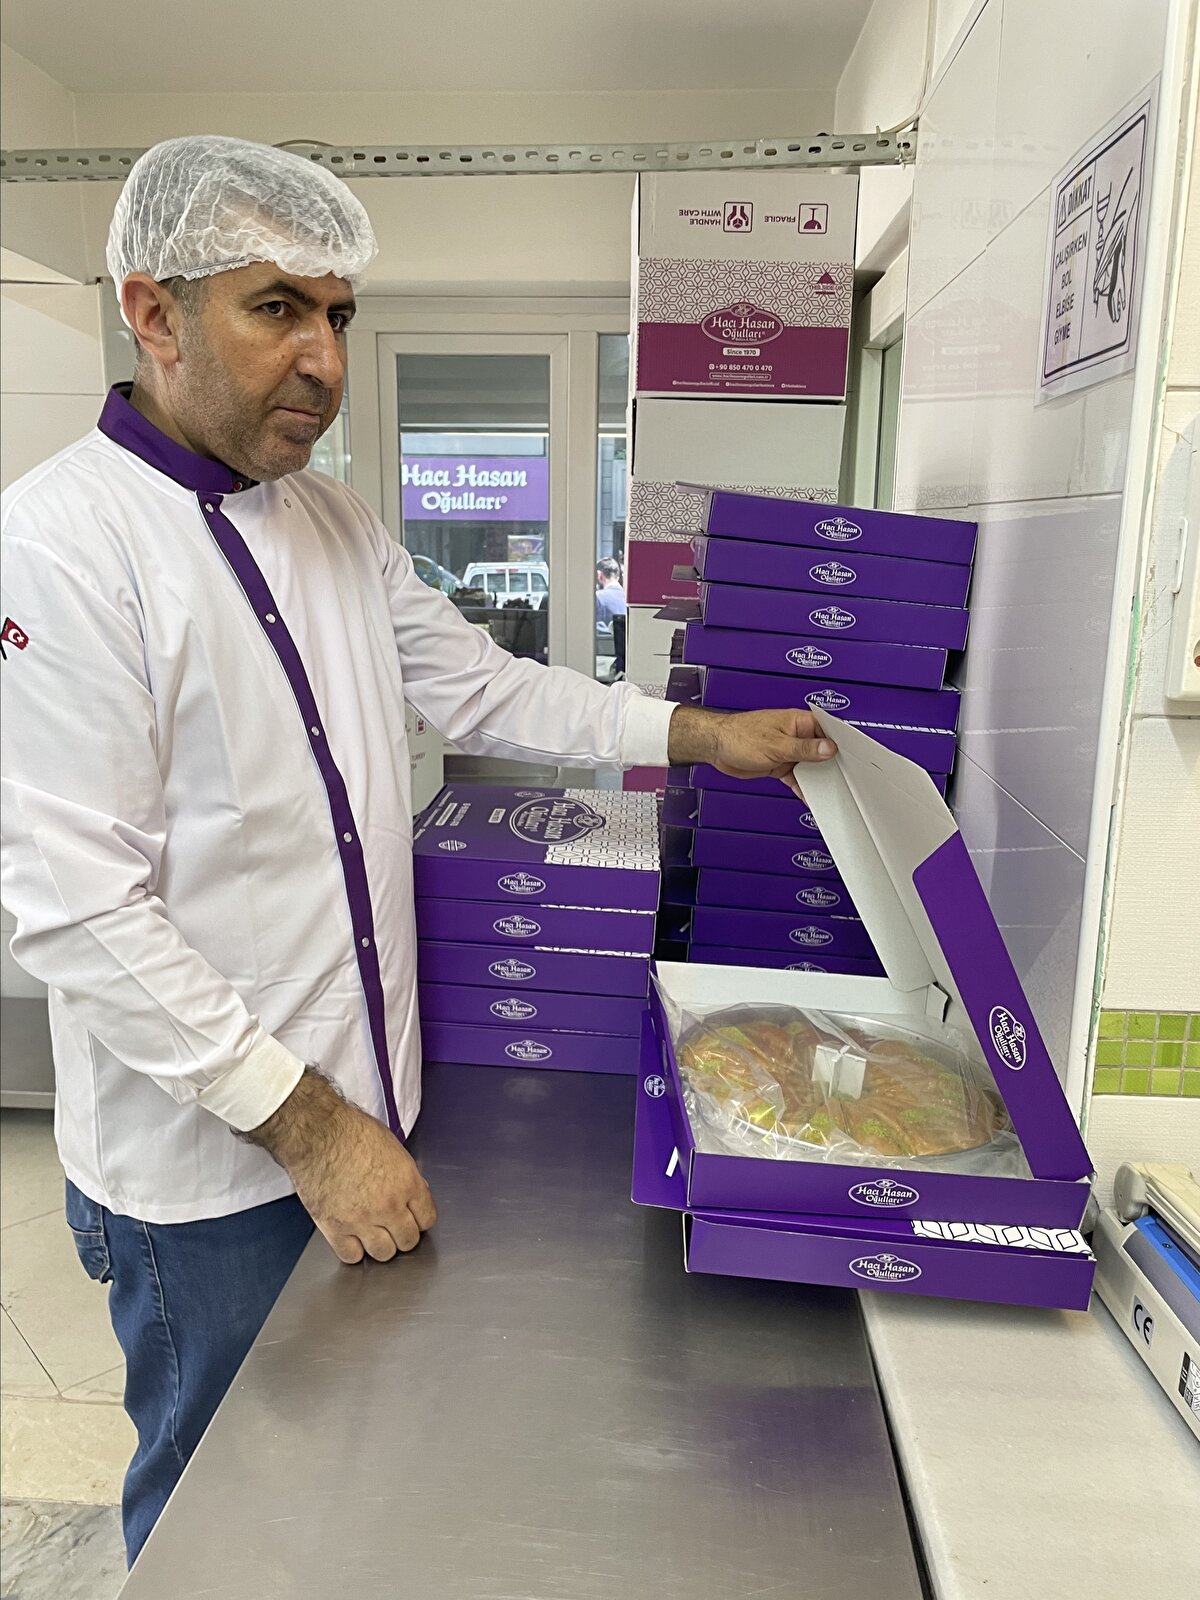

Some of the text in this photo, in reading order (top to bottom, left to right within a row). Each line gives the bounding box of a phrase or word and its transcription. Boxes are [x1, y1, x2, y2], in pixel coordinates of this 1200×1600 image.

[1068, 174, 1092, 216] DİKKAT
[678, 209, 722, 217] WITH CARE
[764, 215, 796, 223] FRAGILE
[689, 218, 721, 226] HANDLE
[1055, 231, 1088, 273] ÇALIŞIRKEN
[1061, 269, 1072, 290] BOL
[710, 316, 775, 329] Hacı Hasan
[722, 328, 761, 340] Oğulları
[401, 464, 528, 487] Hacı Hasan
[421, 491, 502, 513] Oğulları
[836, 525, 858, 533] Hasan
[831, 569, 852, 578] Hasan
[830, 614, 852, 622] Hasan
[807, 653, 828, 661] Hasan
[996, 1012, 1010, 1034] Hacı
[1005, 1034, 1022, 1063] Hasan
[857, 1186, 912, 1198] Hacı Hasan
[866, 1195, 900, 1204] Oğulları
[857, 1259, 914, 1273] Hacı Hasan
[867, 1269, 902, 1278] Oğulları
[1134, 1304, 1153, 1345] CE
